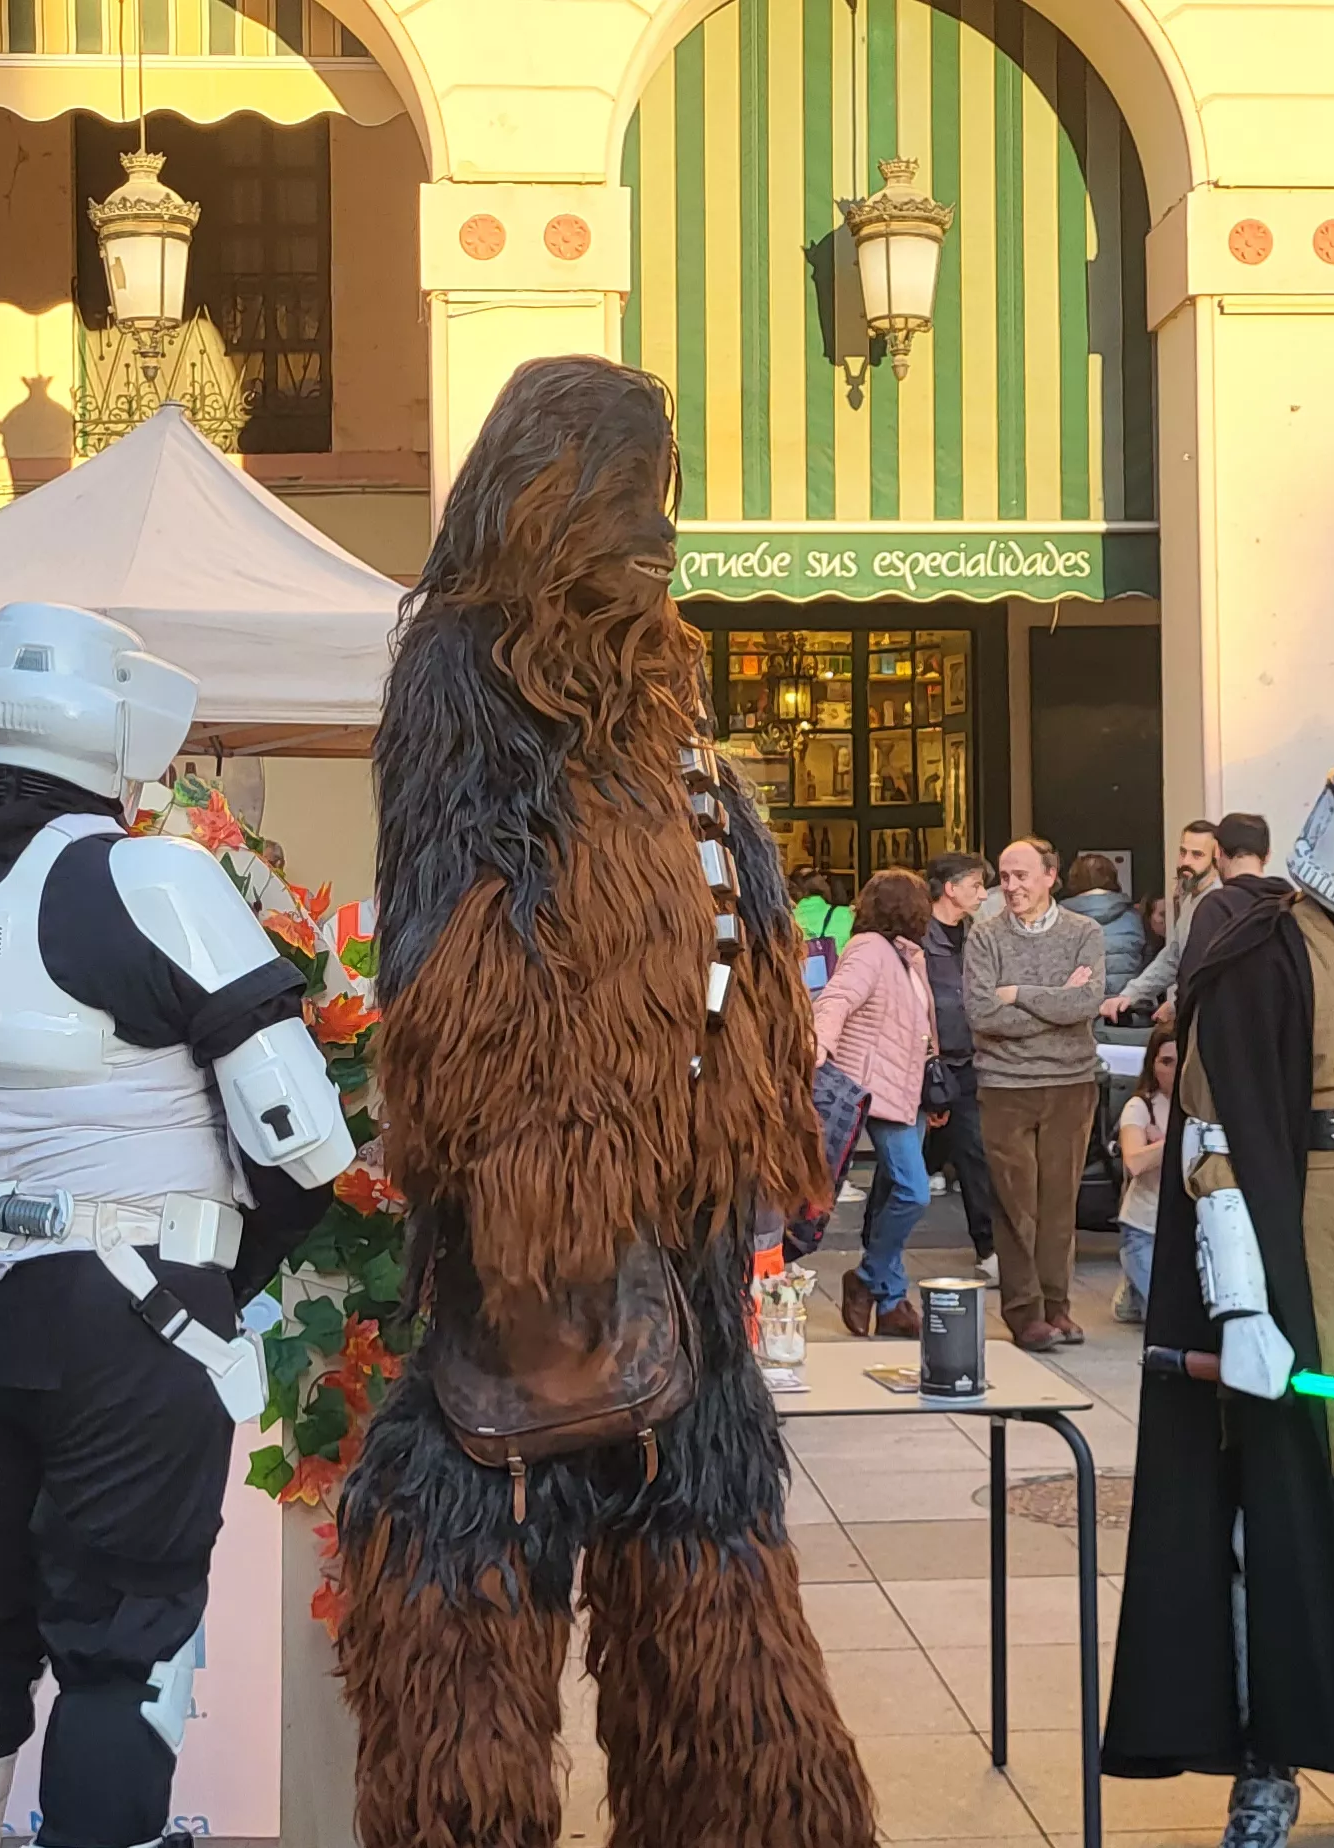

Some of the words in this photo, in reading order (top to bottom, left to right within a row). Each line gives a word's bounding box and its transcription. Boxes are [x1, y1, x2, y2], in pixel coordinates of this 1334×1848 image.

[679, 541, 791, 590] pruebe
[804, 549, 857, 578] sus
[873, 541, 1091, 591] especialidades
